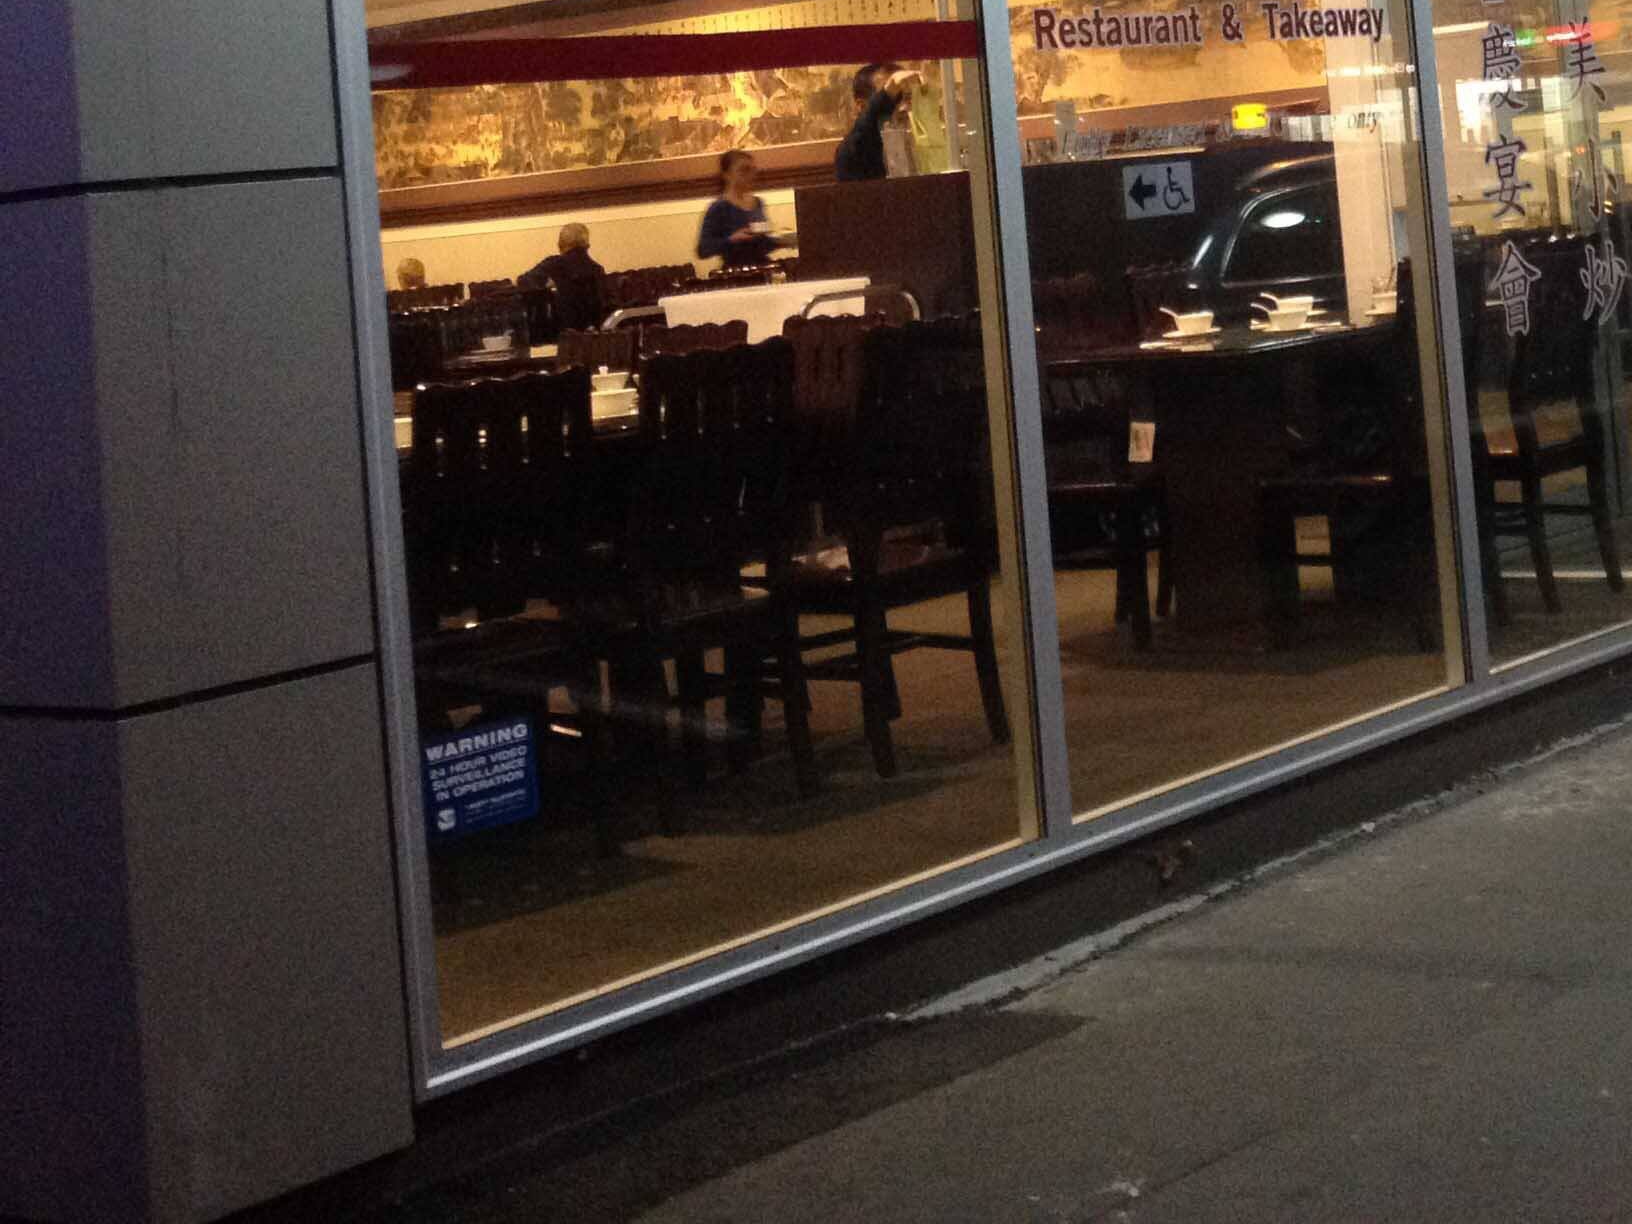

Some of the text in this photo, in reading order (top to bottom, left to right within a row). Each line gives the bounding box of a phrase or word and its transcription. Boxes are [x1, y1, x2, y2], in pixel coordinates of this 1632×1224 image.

[1033, 3, 1385, 51] Restaurant & Takeaway
[425, 723, 528, 761] WARNING
[489, 745, 527, 763] VIDEO
[452, 769, 525, 797] OPERATION
